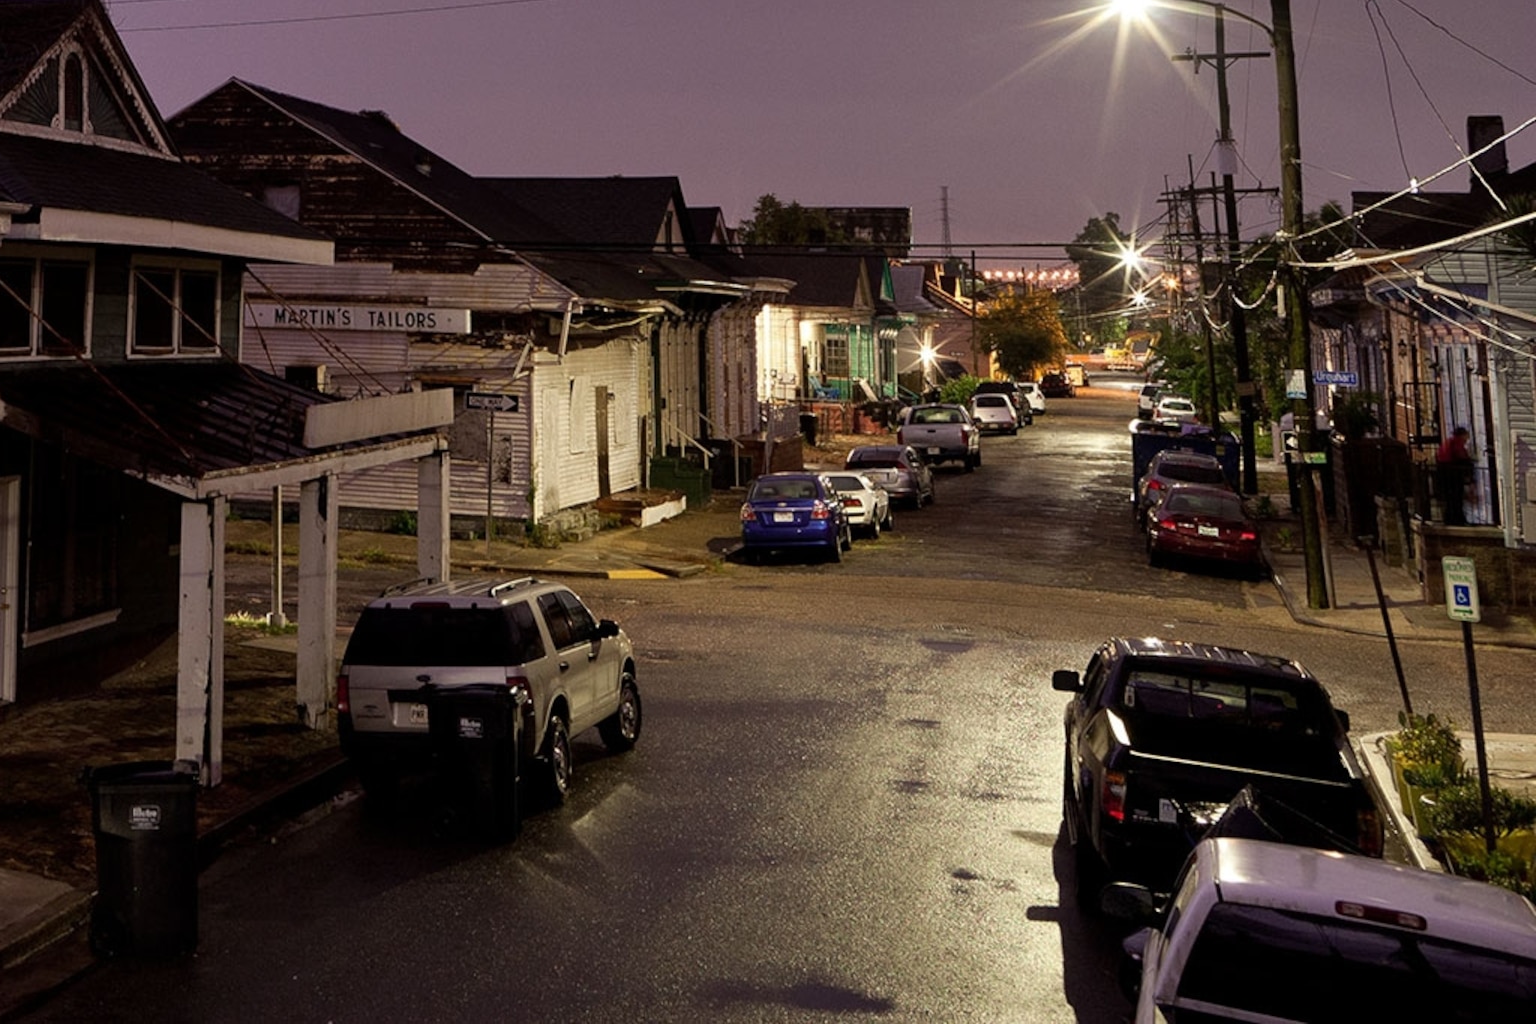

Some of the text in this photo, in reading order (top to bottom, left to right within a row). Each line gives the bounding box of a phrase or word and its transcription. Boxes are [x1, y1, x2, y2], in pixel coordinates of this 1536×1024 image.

[274, 308, 437, 328] MARTIN'S TAILORS
[1316, 370, 1355, 384] Urquhart
